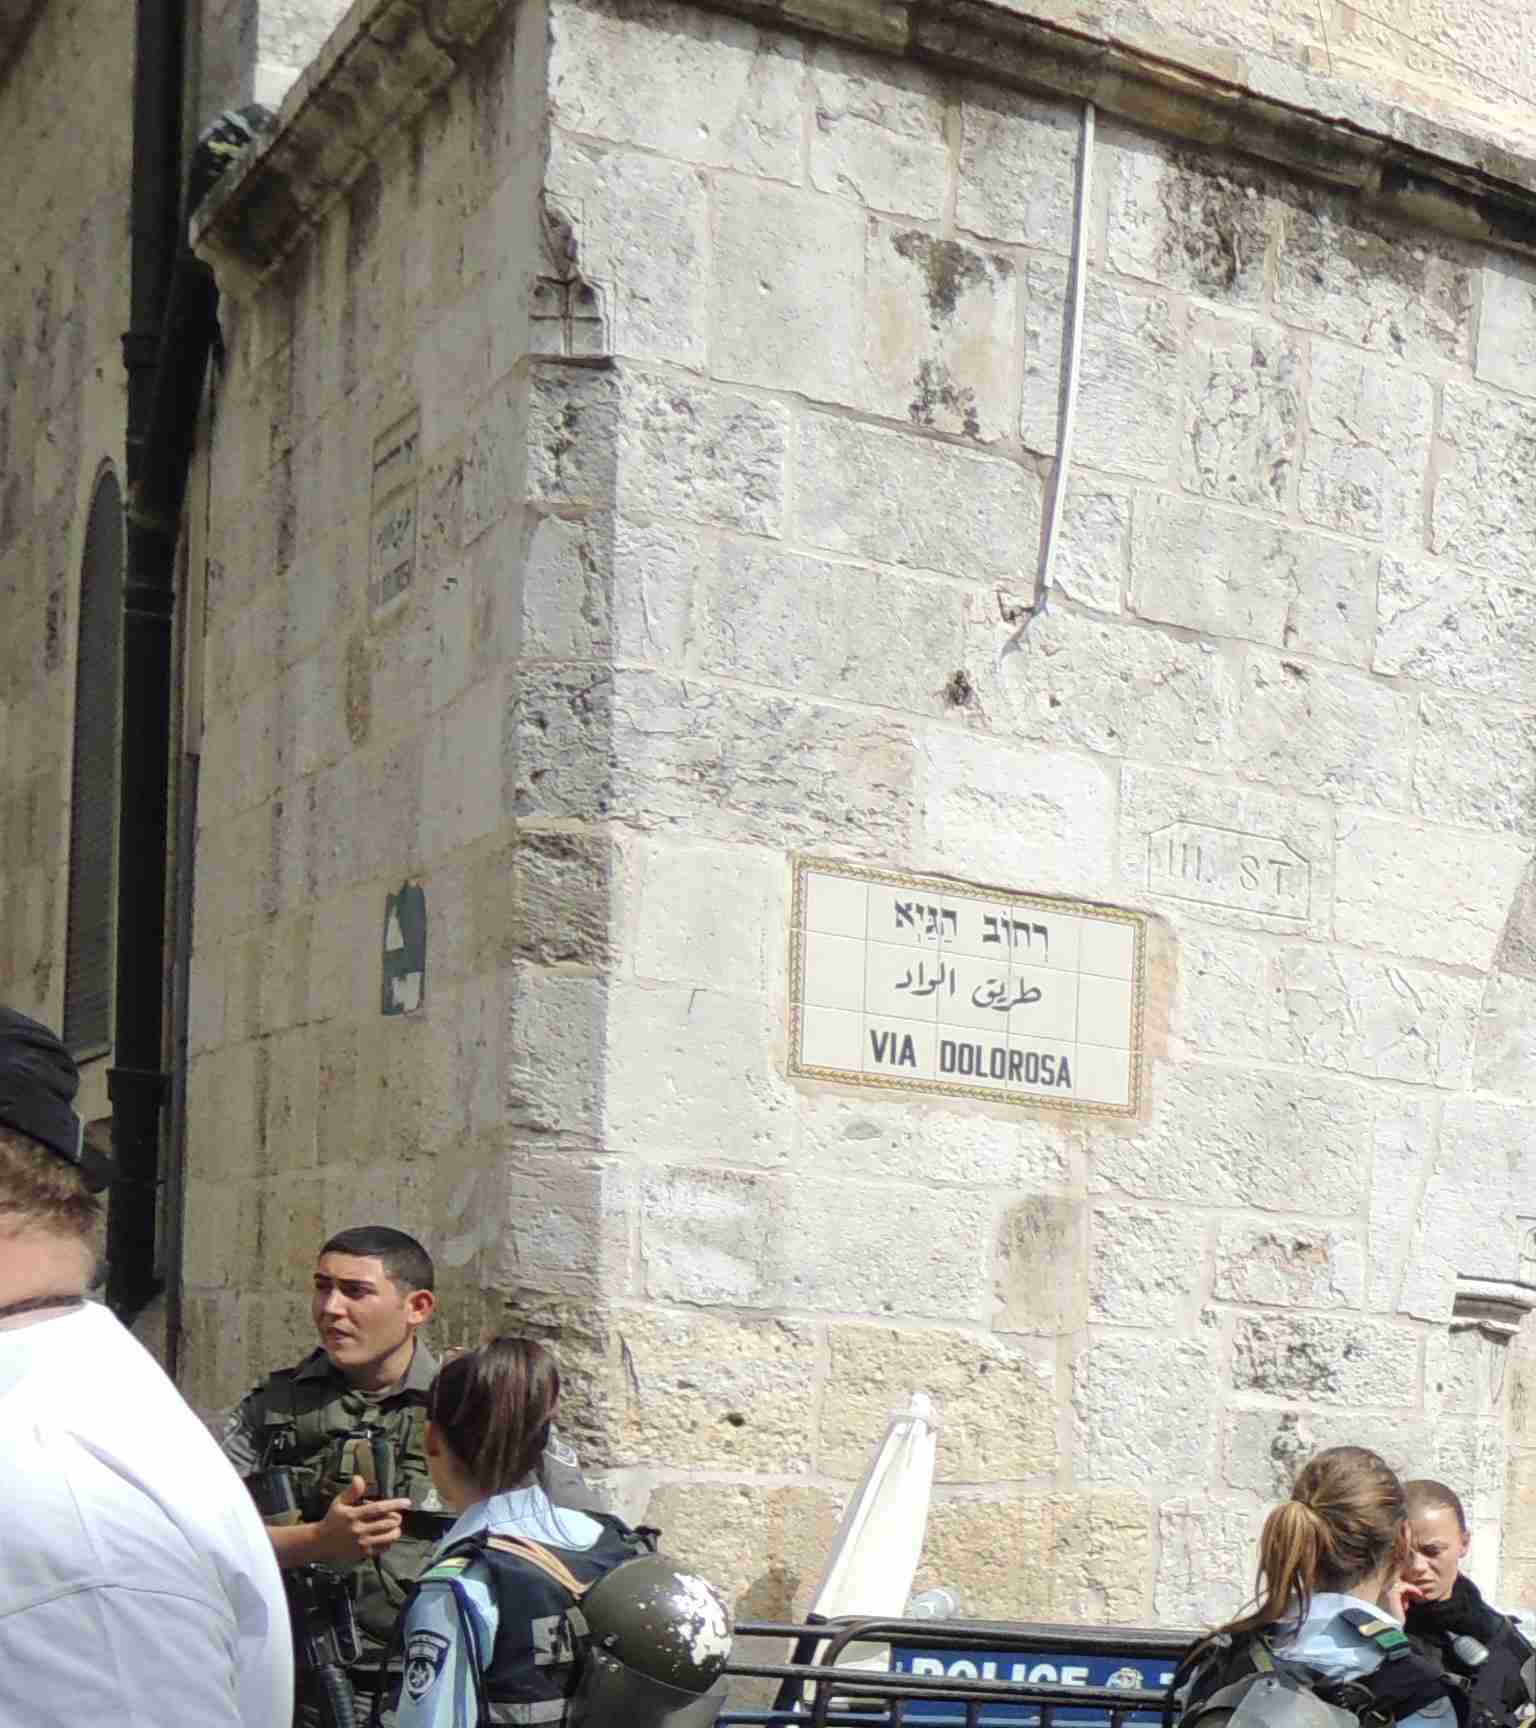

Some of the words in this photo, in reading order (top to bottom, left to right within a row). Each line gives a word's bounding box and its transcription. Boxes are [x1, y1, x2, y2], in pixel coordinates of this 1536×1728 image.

[894, 960, 955, 997] الواد
[971, 975, 1043, 1012] طريق
[869, 1028, 917, 1068] VIA
[939, 1039, 1072, 1089] DOLOROSA
